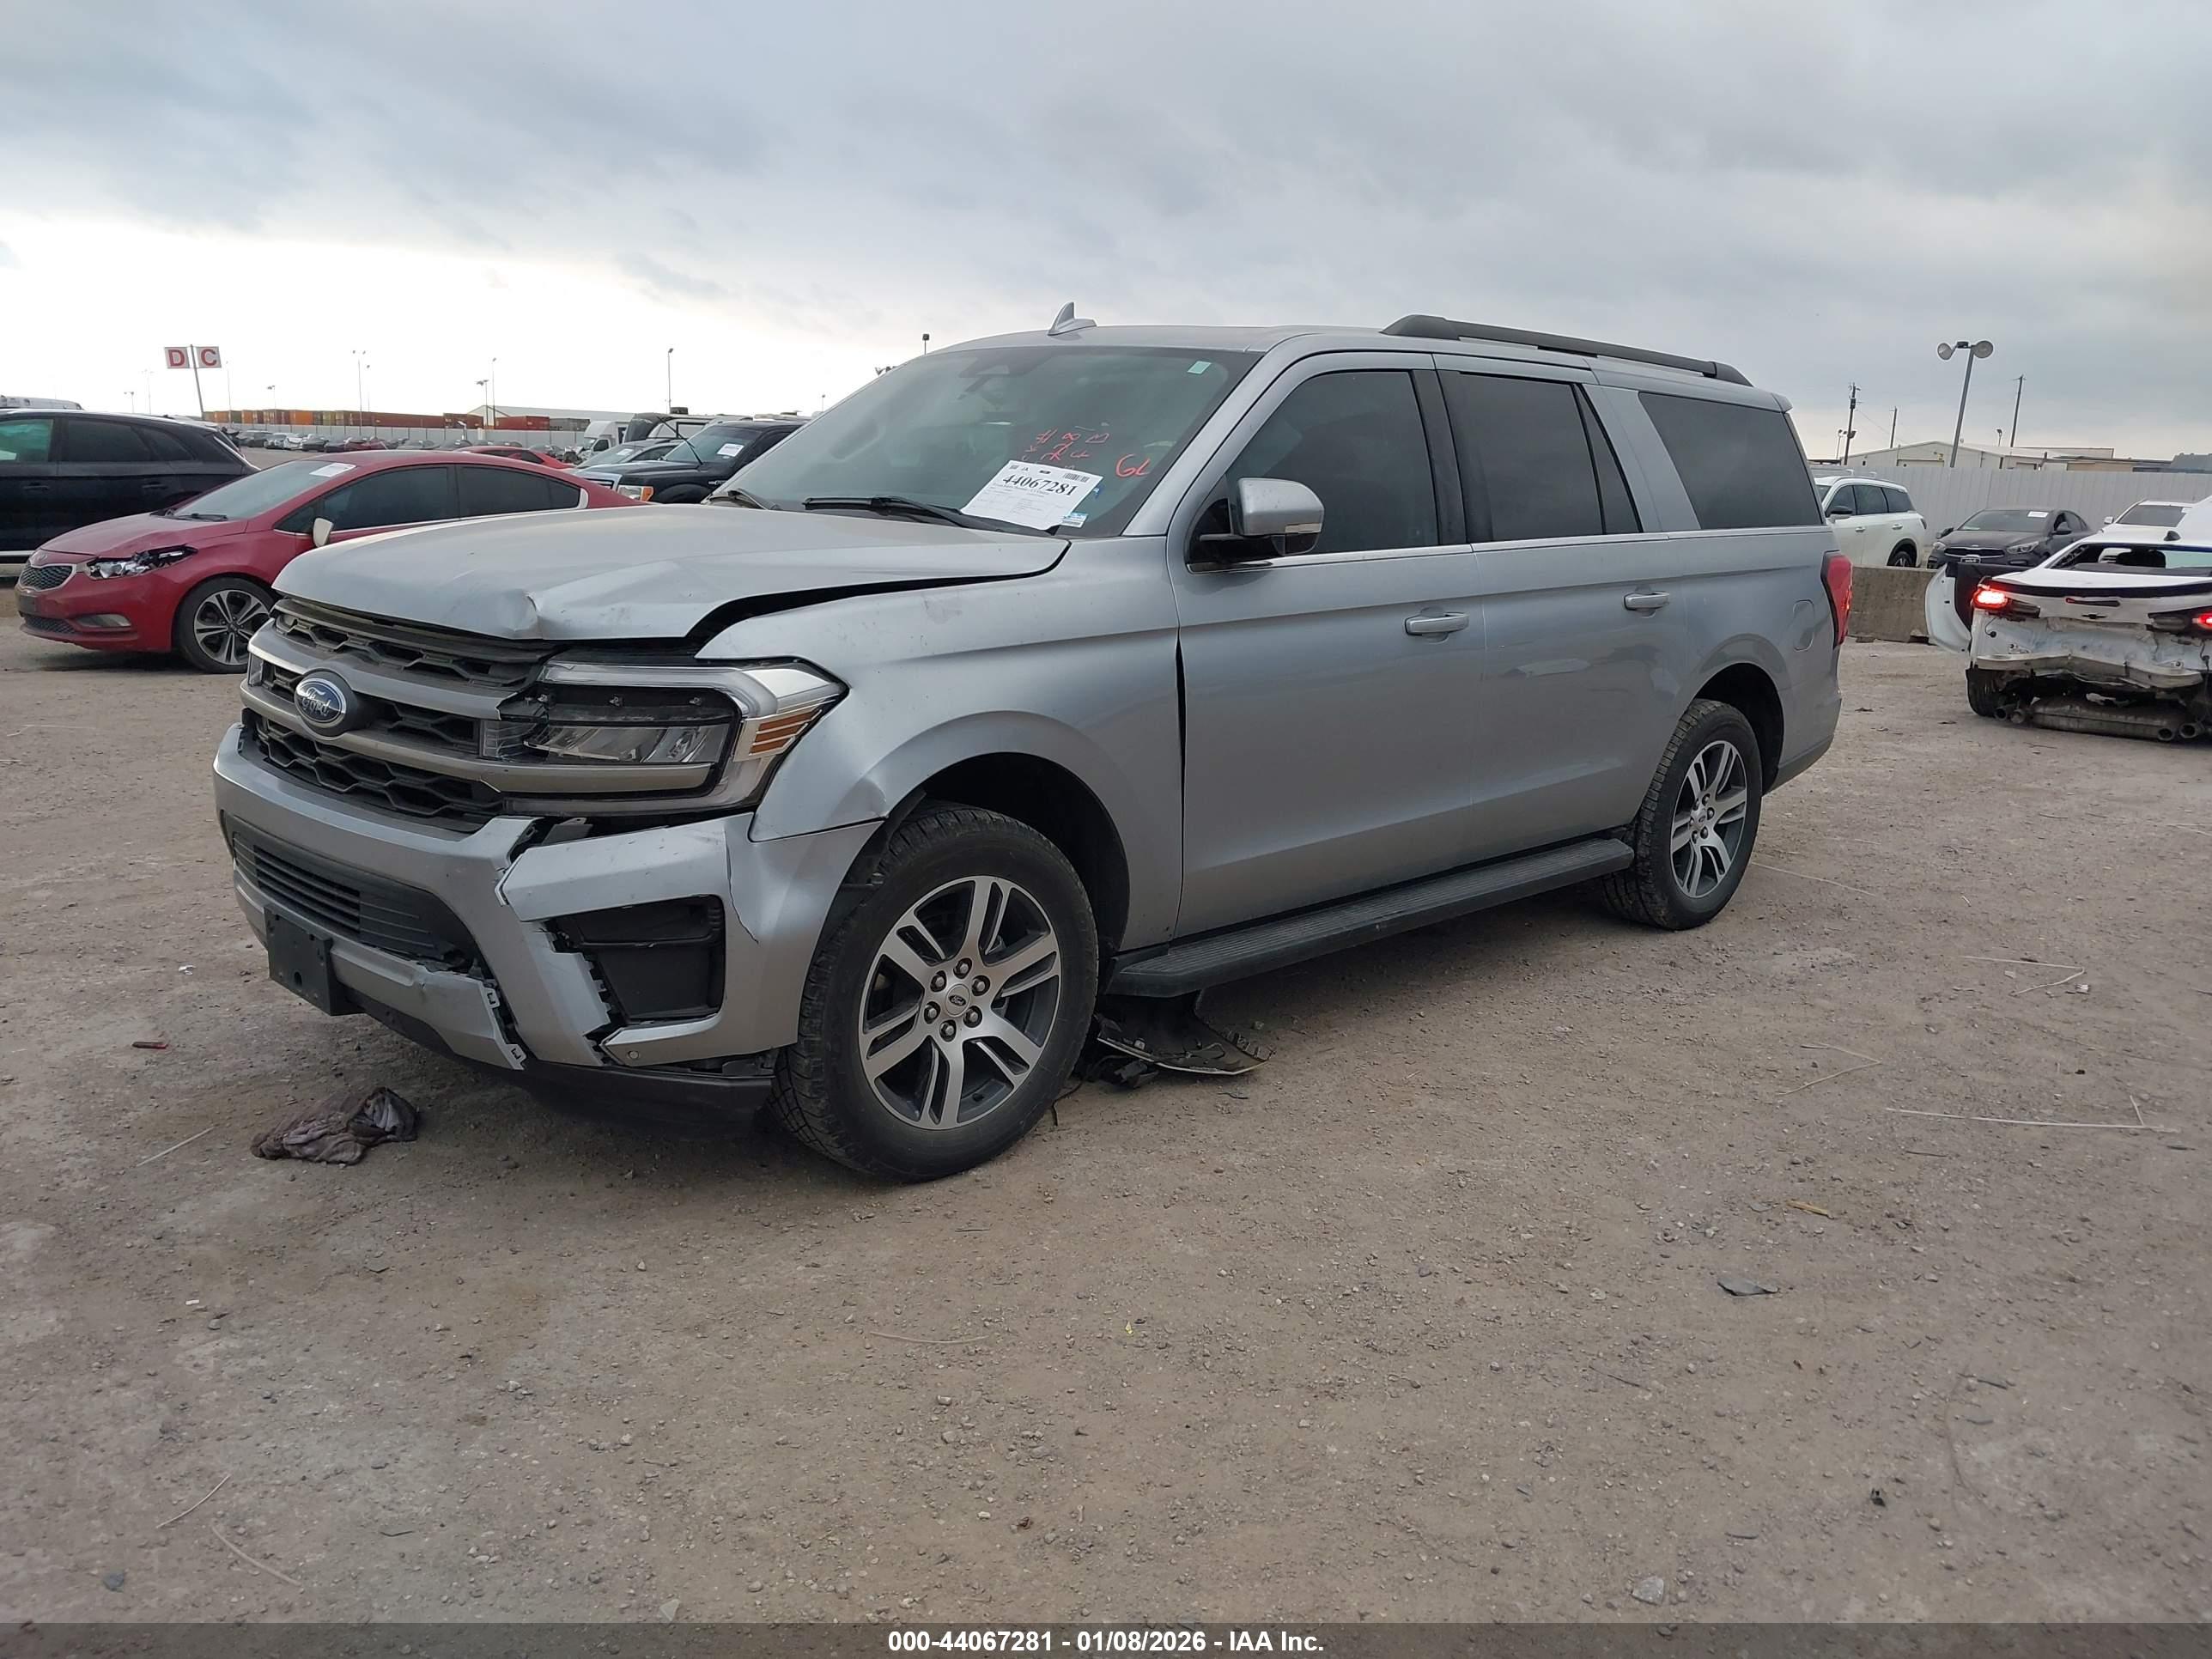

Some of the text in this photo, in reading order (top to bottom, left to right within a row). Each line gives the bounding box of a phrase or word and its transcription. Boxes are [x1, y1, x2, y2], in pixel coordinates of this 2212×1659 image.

[167, 349, 185, 368] D
[200, 348, 217, 367] C
[1002, 474, 1079, 496] 44067281
